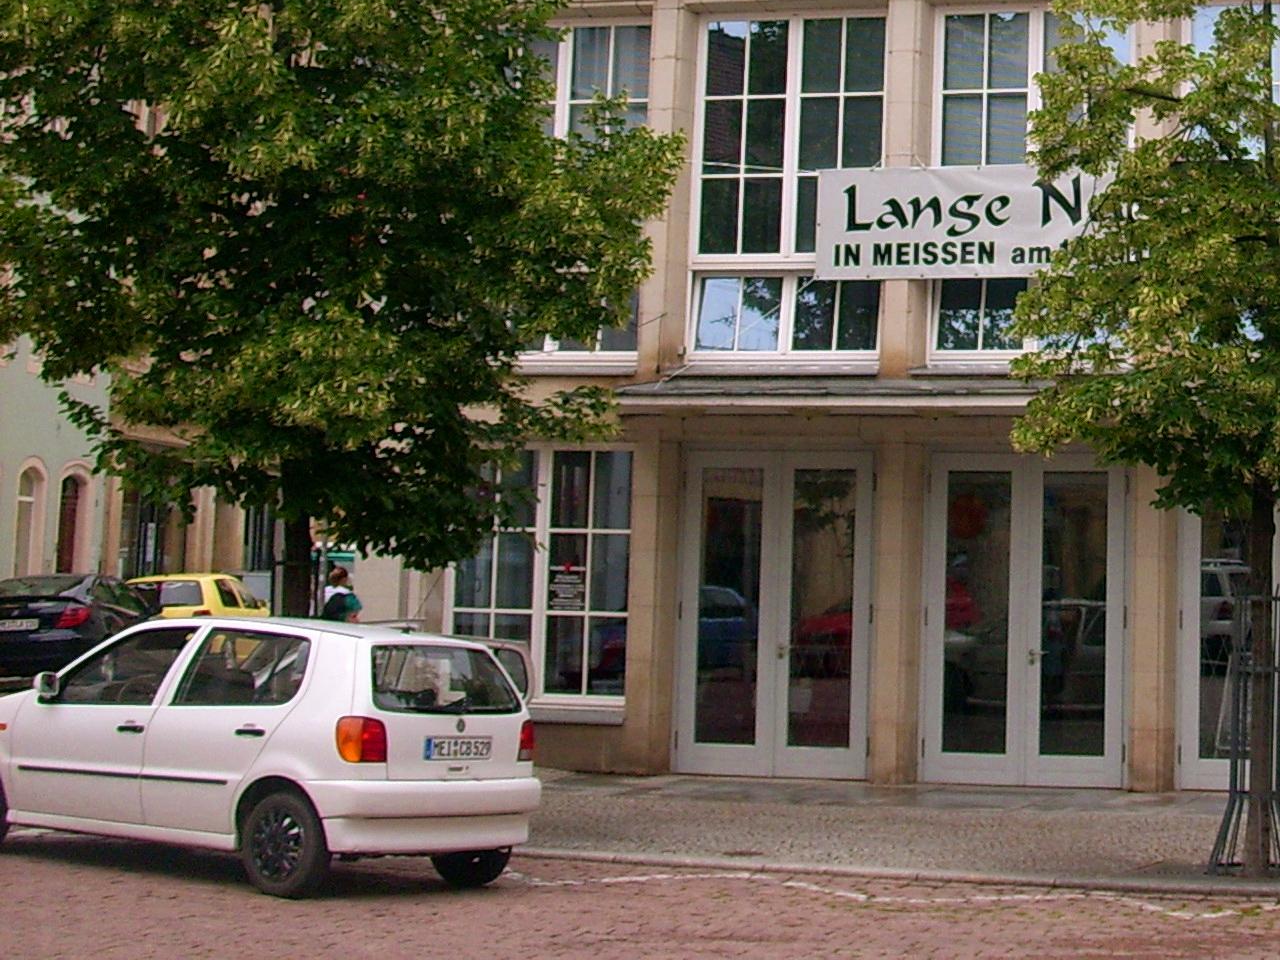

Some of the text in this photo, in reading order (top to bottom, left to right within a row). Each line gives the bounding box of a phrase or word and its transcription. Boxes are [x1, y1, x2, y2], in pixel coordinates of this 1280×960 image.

[842, 183, 1011, 238] Lange
[833, 243, 861, 267] IN
[872, 241, 995, 266] MEISSEN
[1010, 245, 1051, 265] am
